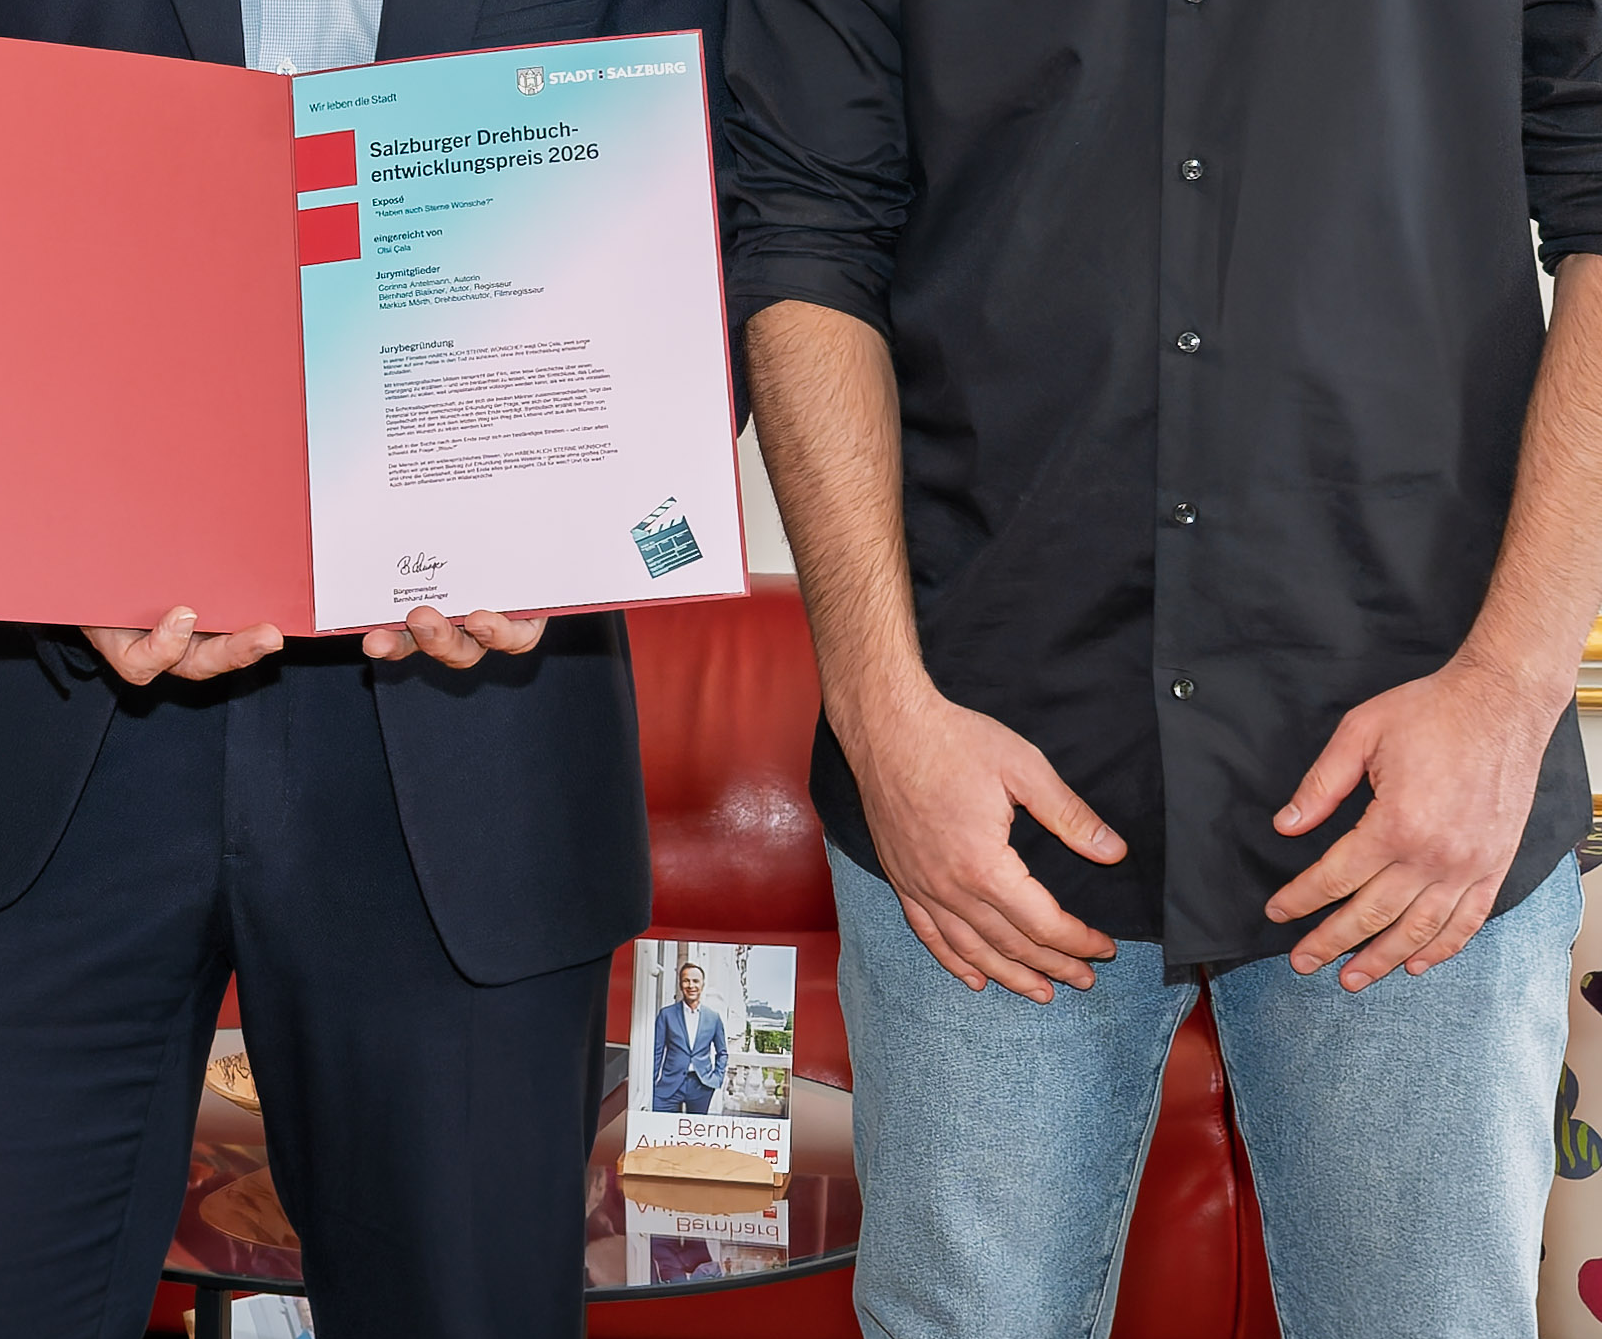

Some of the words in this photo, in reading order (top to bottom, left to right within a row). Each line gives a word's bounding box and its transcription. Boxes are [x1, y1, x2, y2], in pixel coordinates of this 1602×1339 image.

[549, 69, 595, 85] STADT
[606, 61, 687, 80] SALZBURG
[309, 102, 325, 113] Wir
[327, 99, 352, 111] leben
[355, 97, 370, 107] die
[371, 93, 397, 105] Stadt
[370, 133, 472, 158] Salzburger
[477, 121, 579, 146] Drehbuch-
[371, 148, 543, 183] entwicklungspreis
[548, 143, 599, 164] 2026
[405, 206, 423, 215] auch
[374, 230, 424, 243] eingereicht
[426, 228, 443, 237] von
[376, 265, 440, 280] Jurymitglieder
[454, 274, 480, 283] Autorin
[379, 291, 413, 301] Bernhard
[379, 340, 454, 354] Jurybegründung
[678, 1118, 780, 1142] Bernhard
